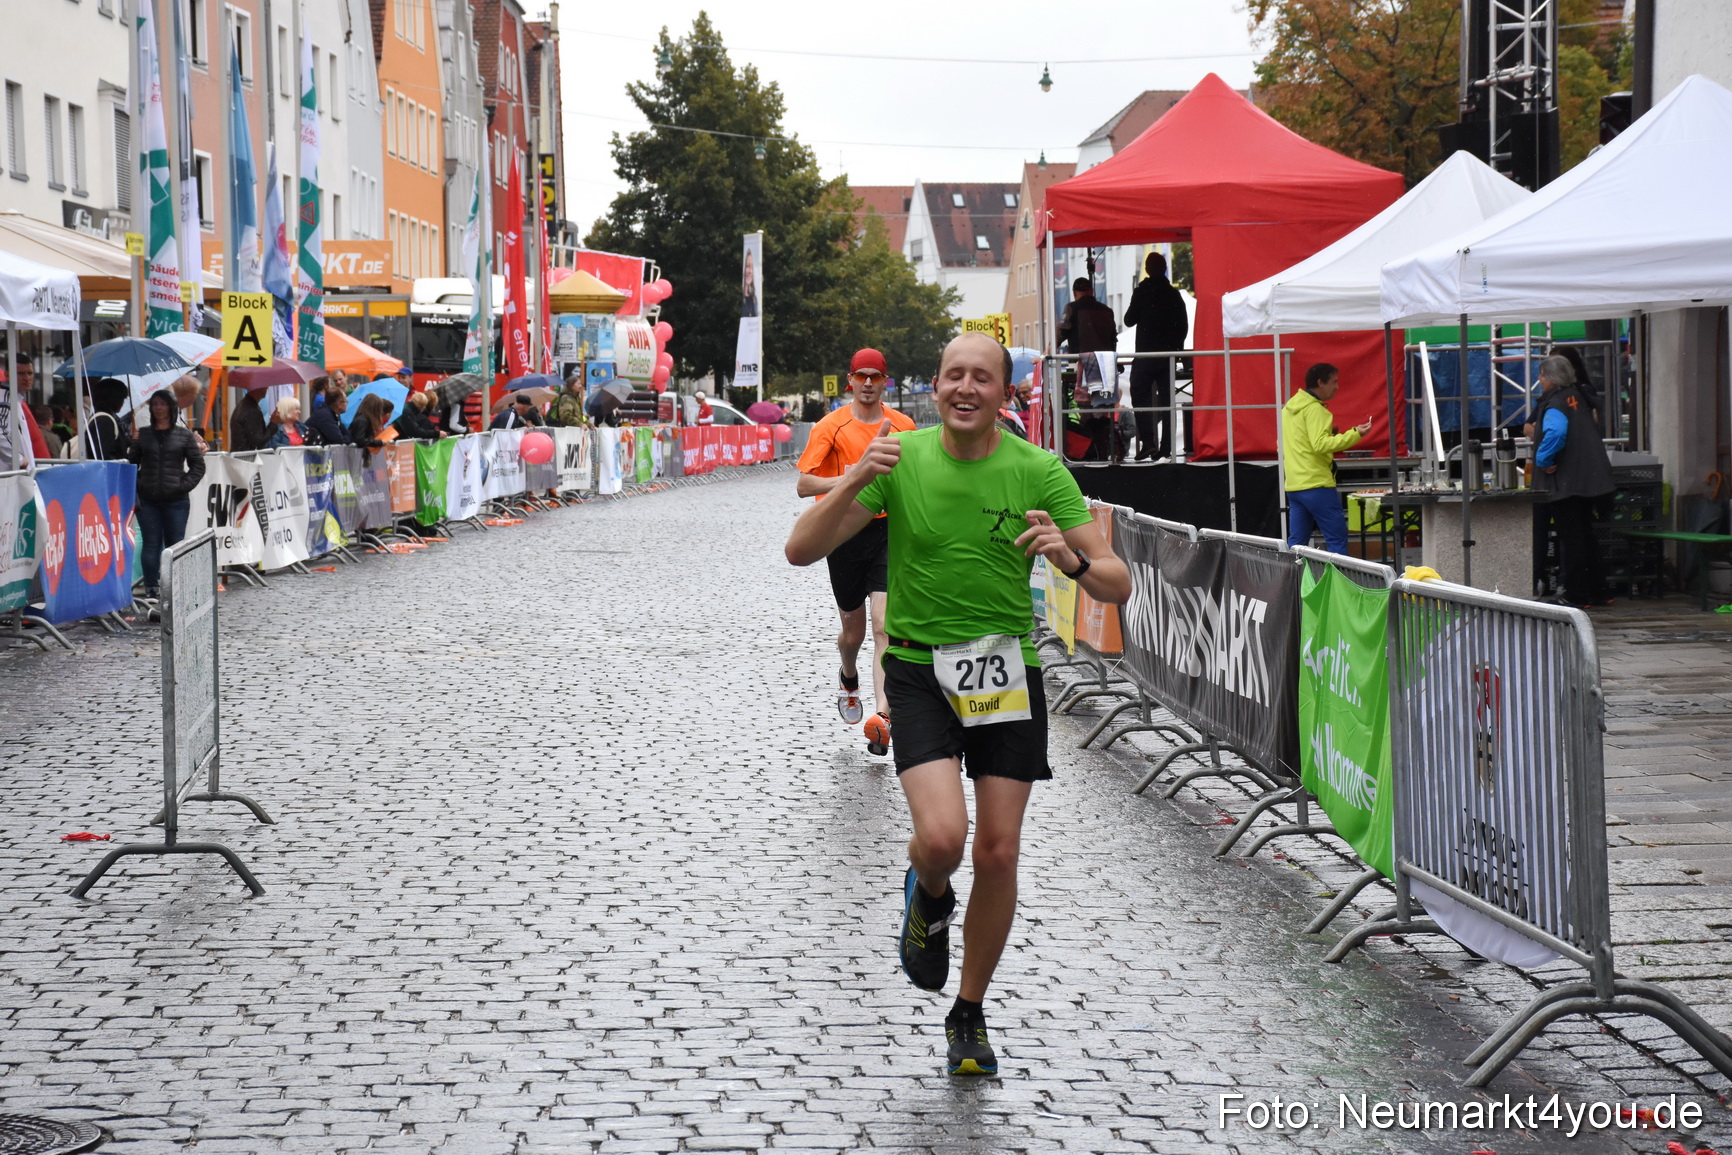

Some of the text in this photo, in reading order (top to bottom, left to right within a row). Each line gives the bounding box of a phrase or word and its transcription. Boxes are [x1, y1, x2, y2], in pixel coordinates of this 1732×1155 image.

[228, 295, 268, 310] Block
[232, 315, 262, 351] A
[966, 321, 994, 332] Block
[626, 325, 651, 351] AVIA
[626, 352, 651, 374] Pellets
[827, 382, 834, 392] D
[78, 513, 110, 566] Hervis
[990, 536, 1011, 545] DAVID
[956, 655, 1008, 691] 273
[969, 697, 1000, 713] David
